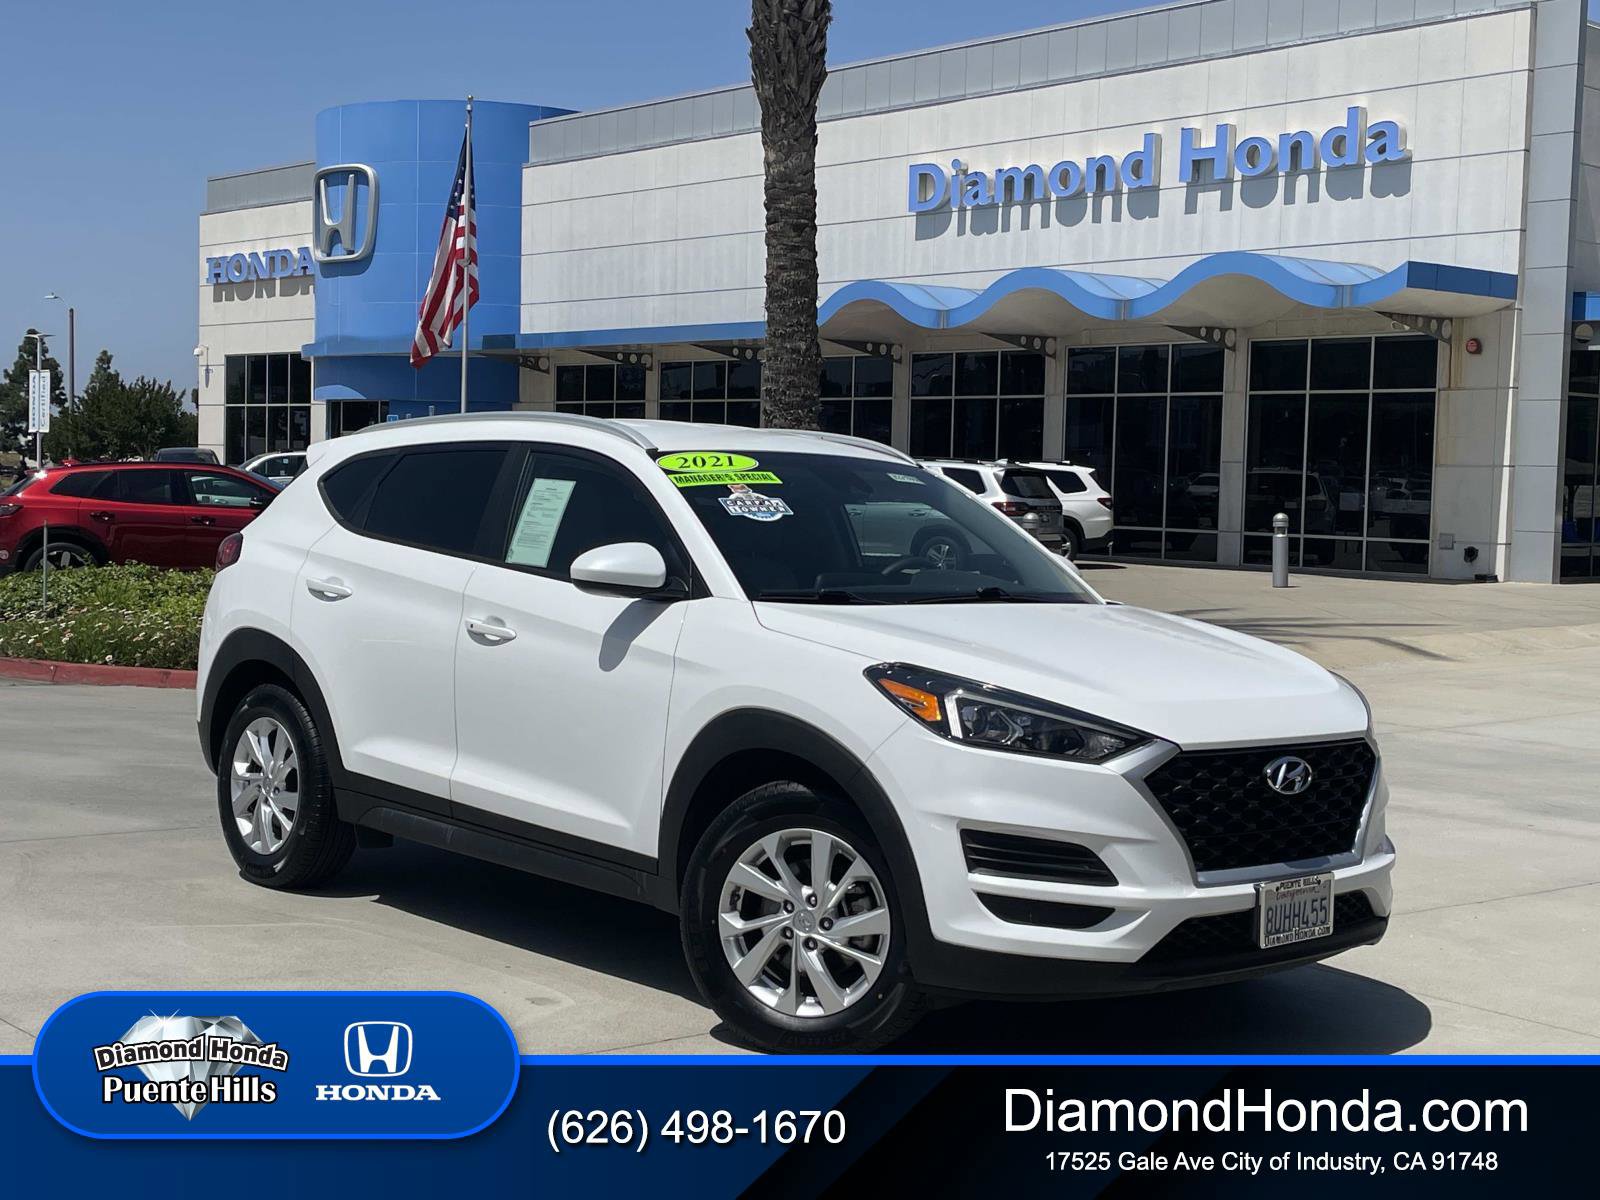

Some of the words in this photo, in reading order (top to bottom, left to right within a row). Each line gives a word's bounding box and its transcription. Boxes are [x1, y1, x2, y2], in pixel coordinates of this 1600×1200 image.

[908, 132, 1162, 213] Diamond
[1179, 105, 1409, 184] Honda
[206, 246, 315, 284] HONDA
[673, 473, 734, 484] MANAGER'S
[733, 472, 776, 482] SPECIAL
[676, 455, 735, 469] 2021
[1266, 896, 1328, 935] 8UHH455
